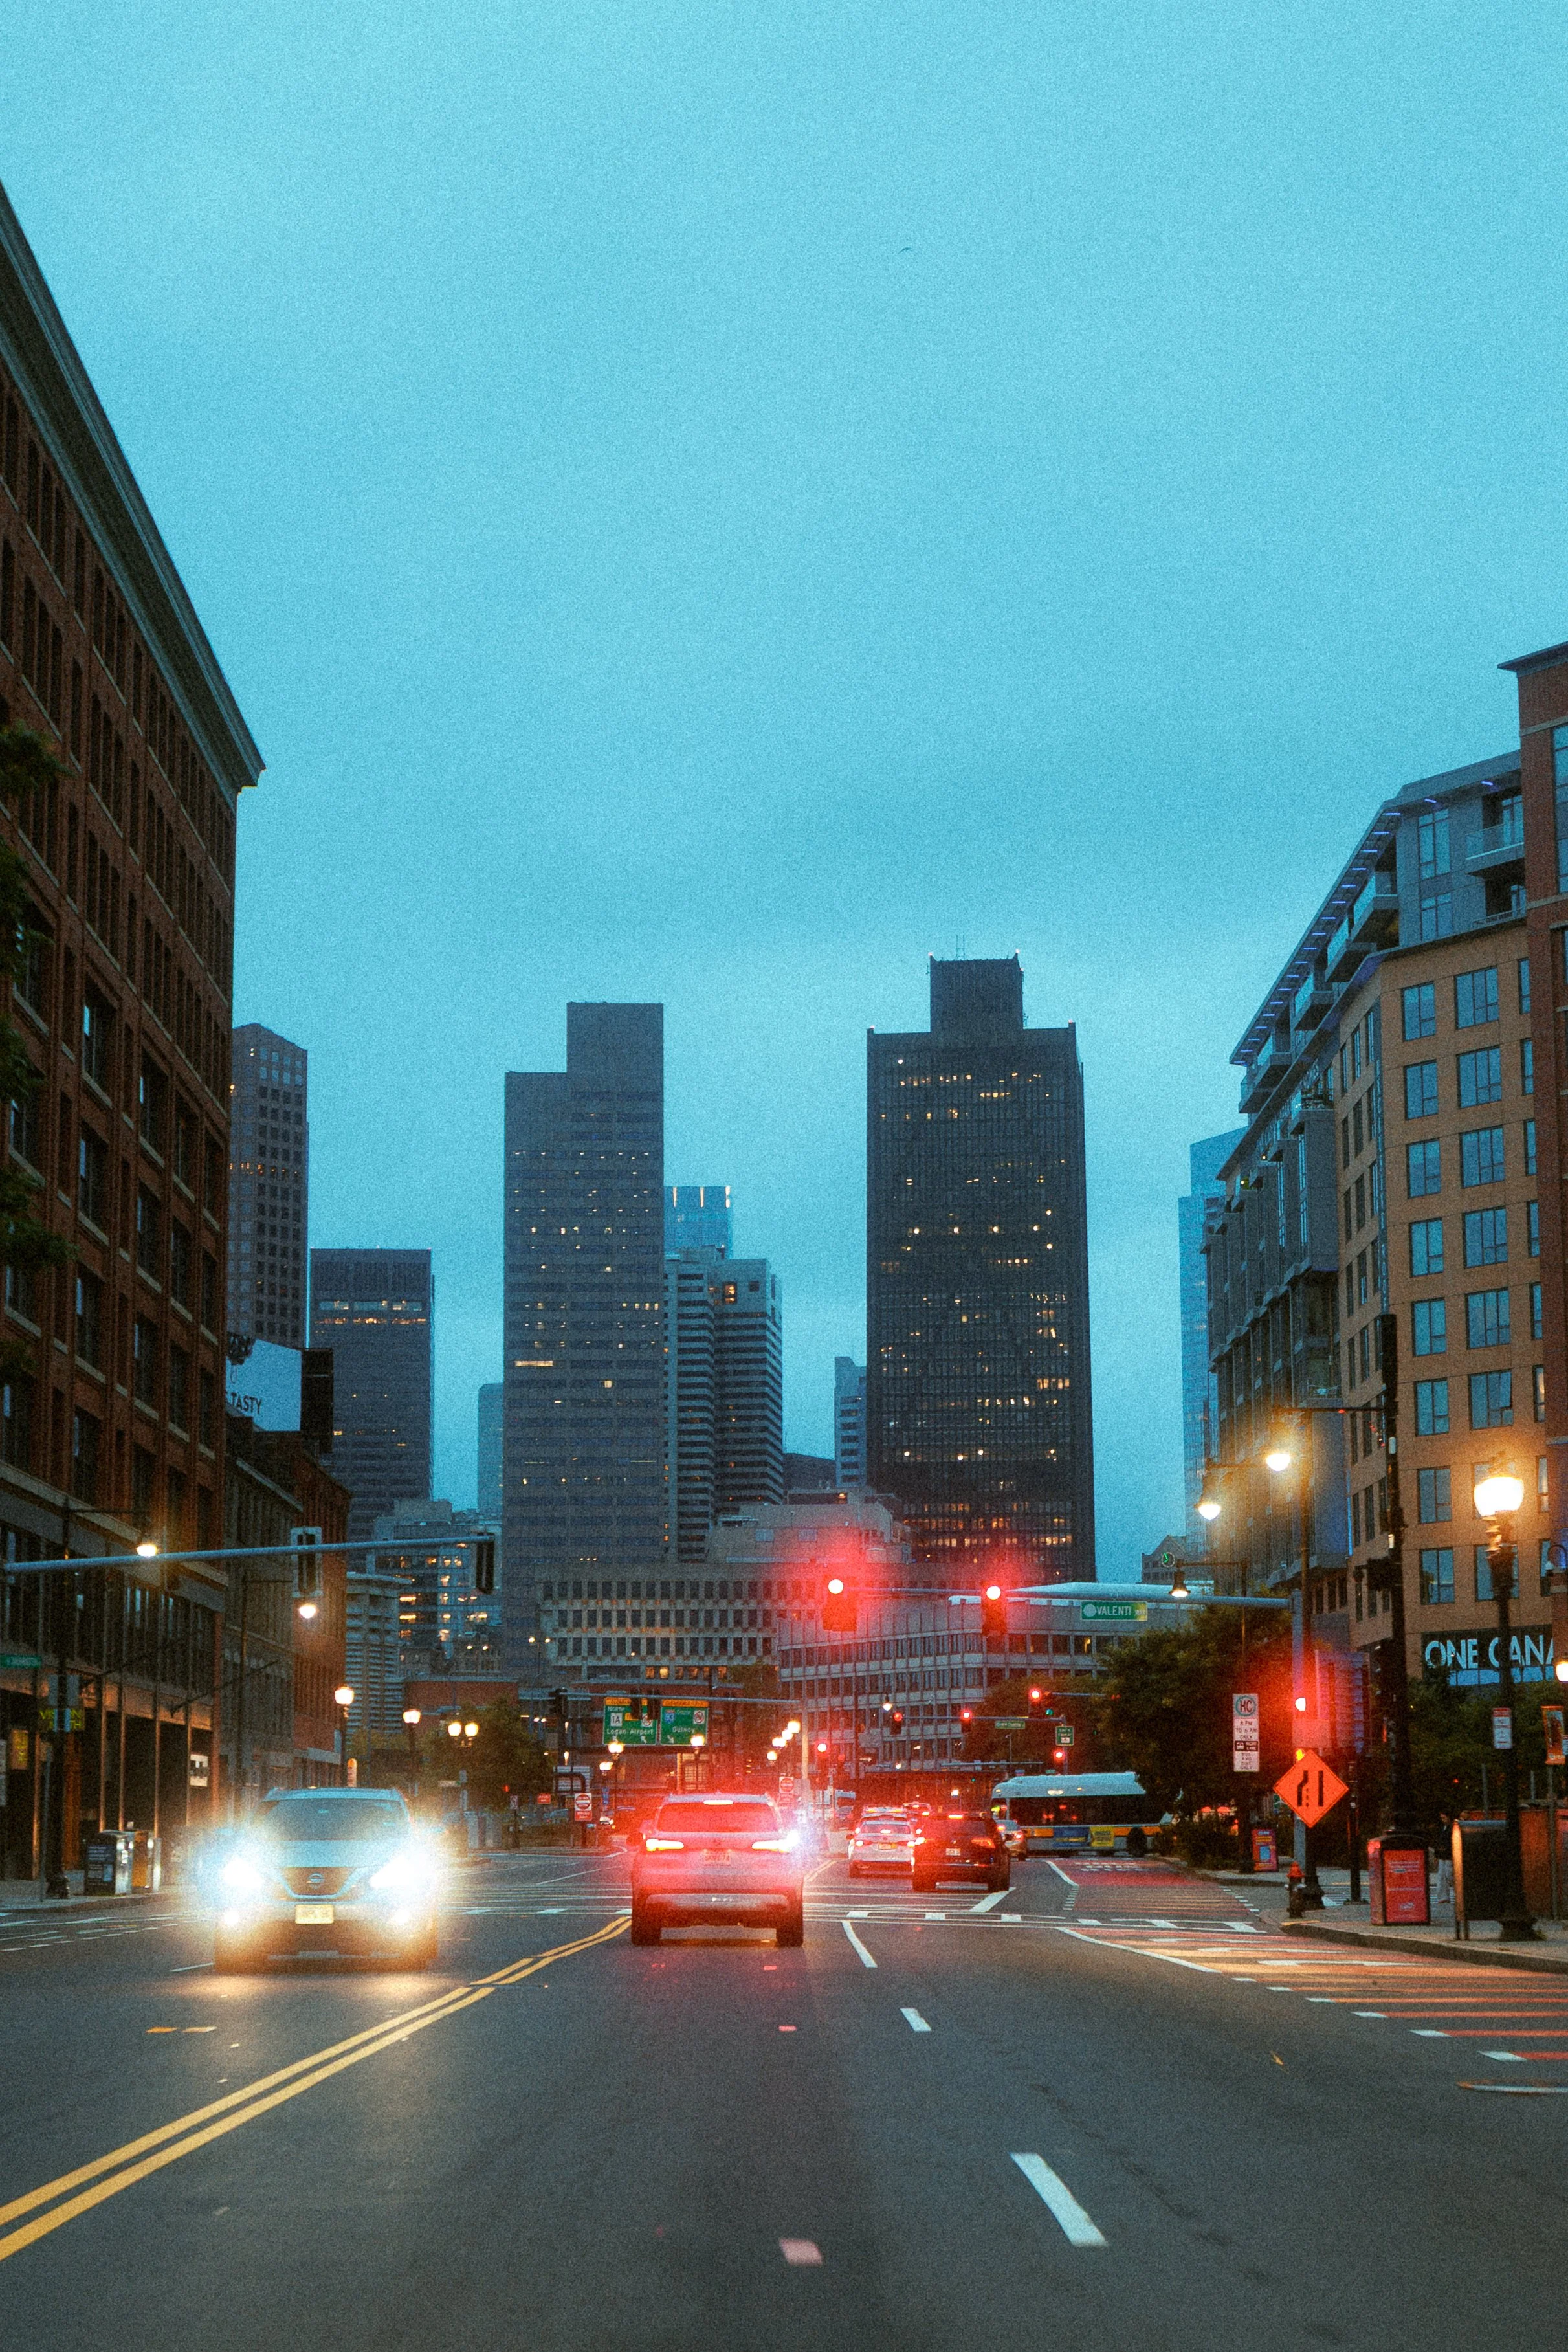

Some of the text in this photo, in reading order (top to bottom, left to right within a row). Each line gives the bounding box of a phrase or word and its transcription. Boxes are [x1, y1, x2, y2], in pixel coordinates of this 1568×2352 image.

[231, 1392, 262, 1414] TASTY
[1096, 1606, 1131, 1615] VALENTI
[1424, 1639, 1479, 1669] ONE
[1240, 1700, 1253, 1713] HC
[612, 1715, 621, 1724] 1A
[672, 1725, 695, 1735] Quincy
